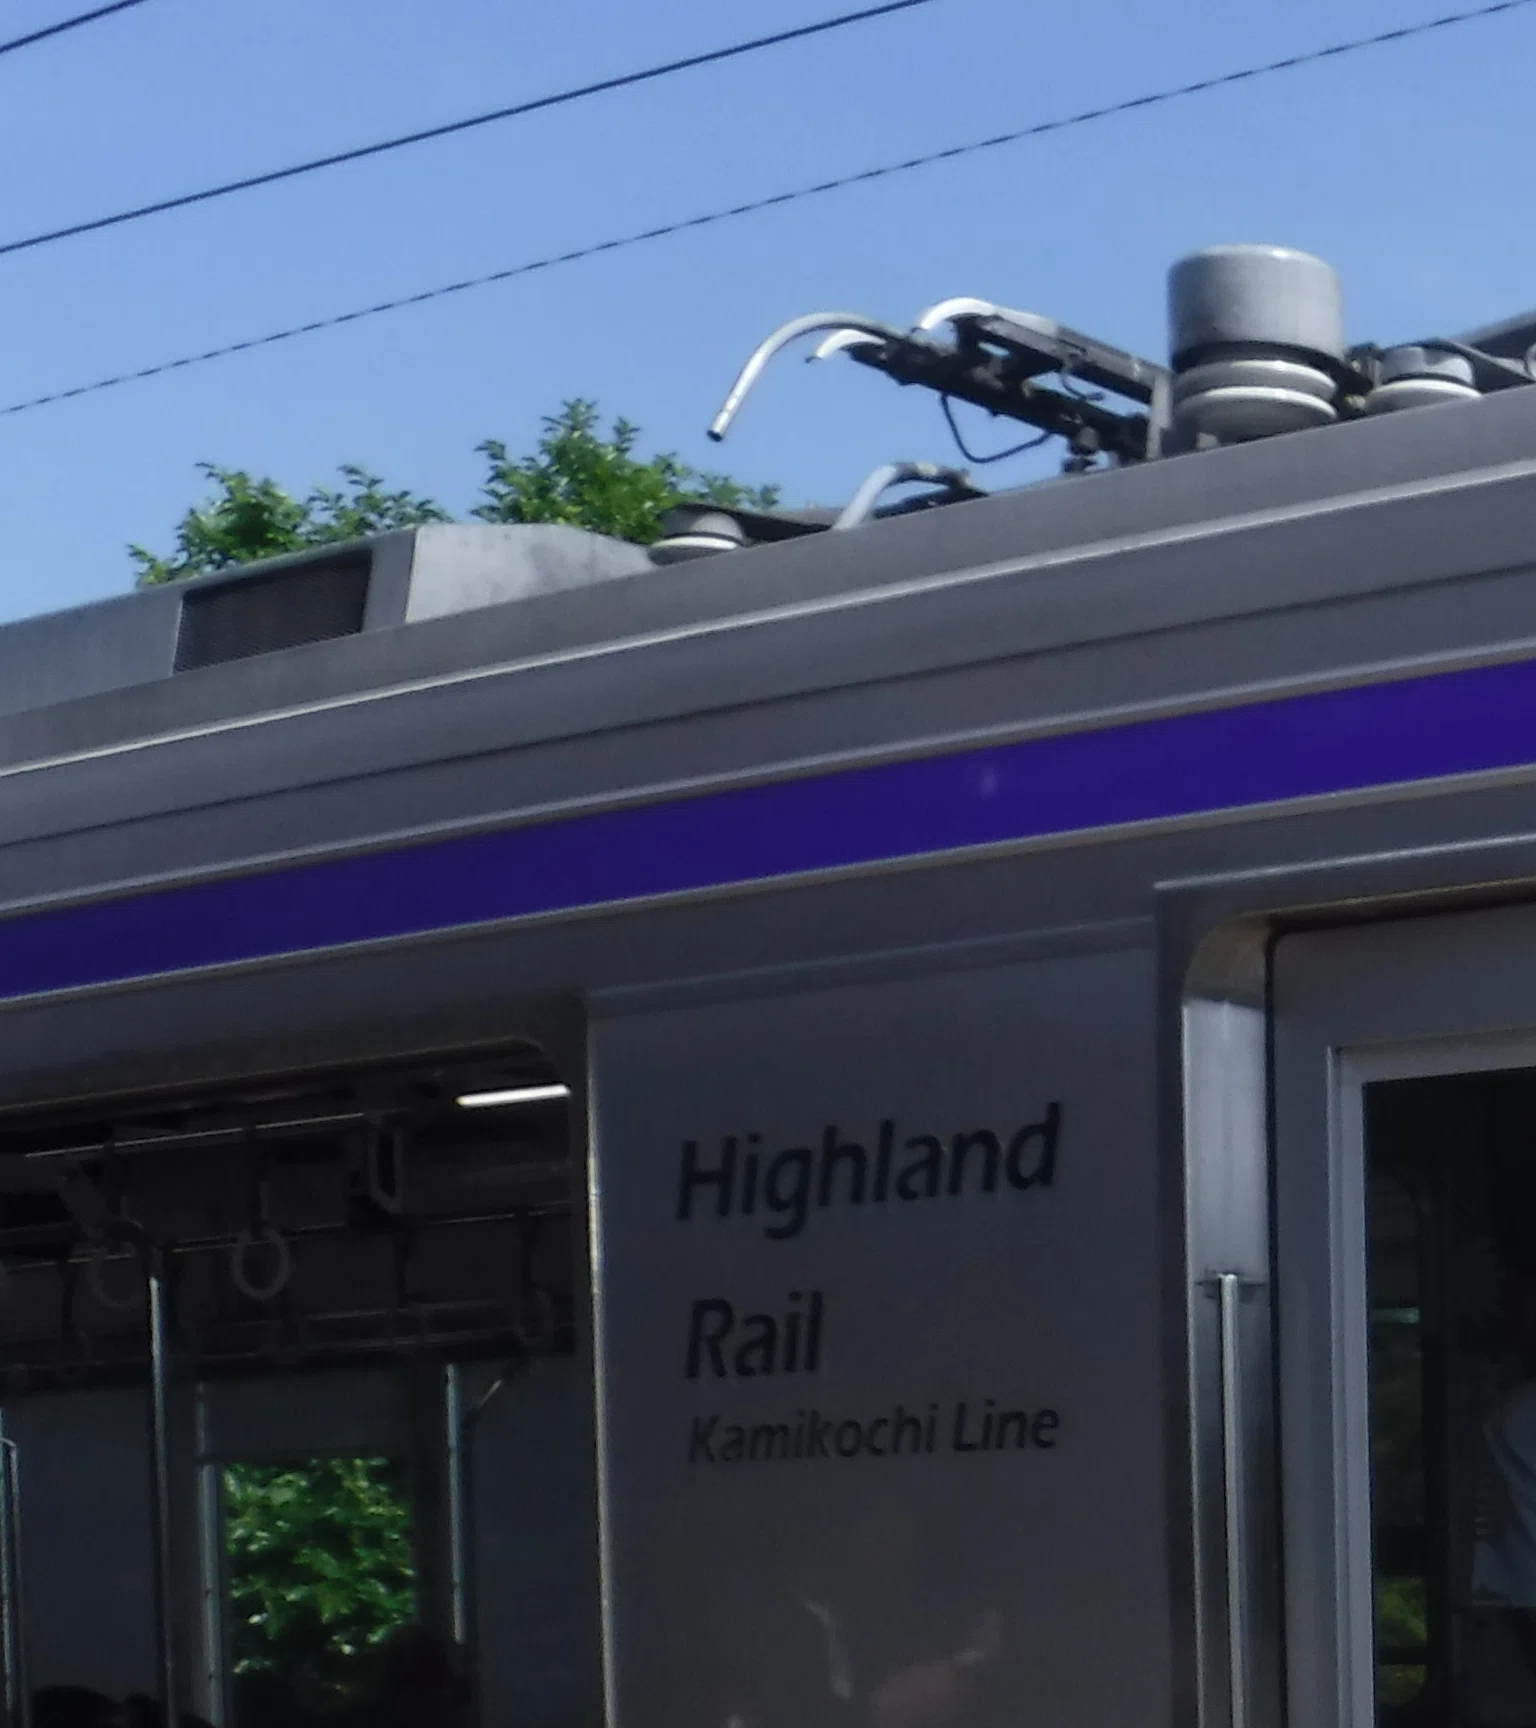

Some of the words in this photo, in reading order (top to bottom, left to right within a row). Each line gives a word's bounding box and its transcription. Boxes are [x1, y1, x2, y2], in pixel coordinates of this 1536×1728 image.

[676, 1101, 1064, 1240] Highland
[685, 1290, 824, 1380] Rail
[687, 1402, 938, 1463] Kamikochi
[951, 1400, 1062, 1454] Line
